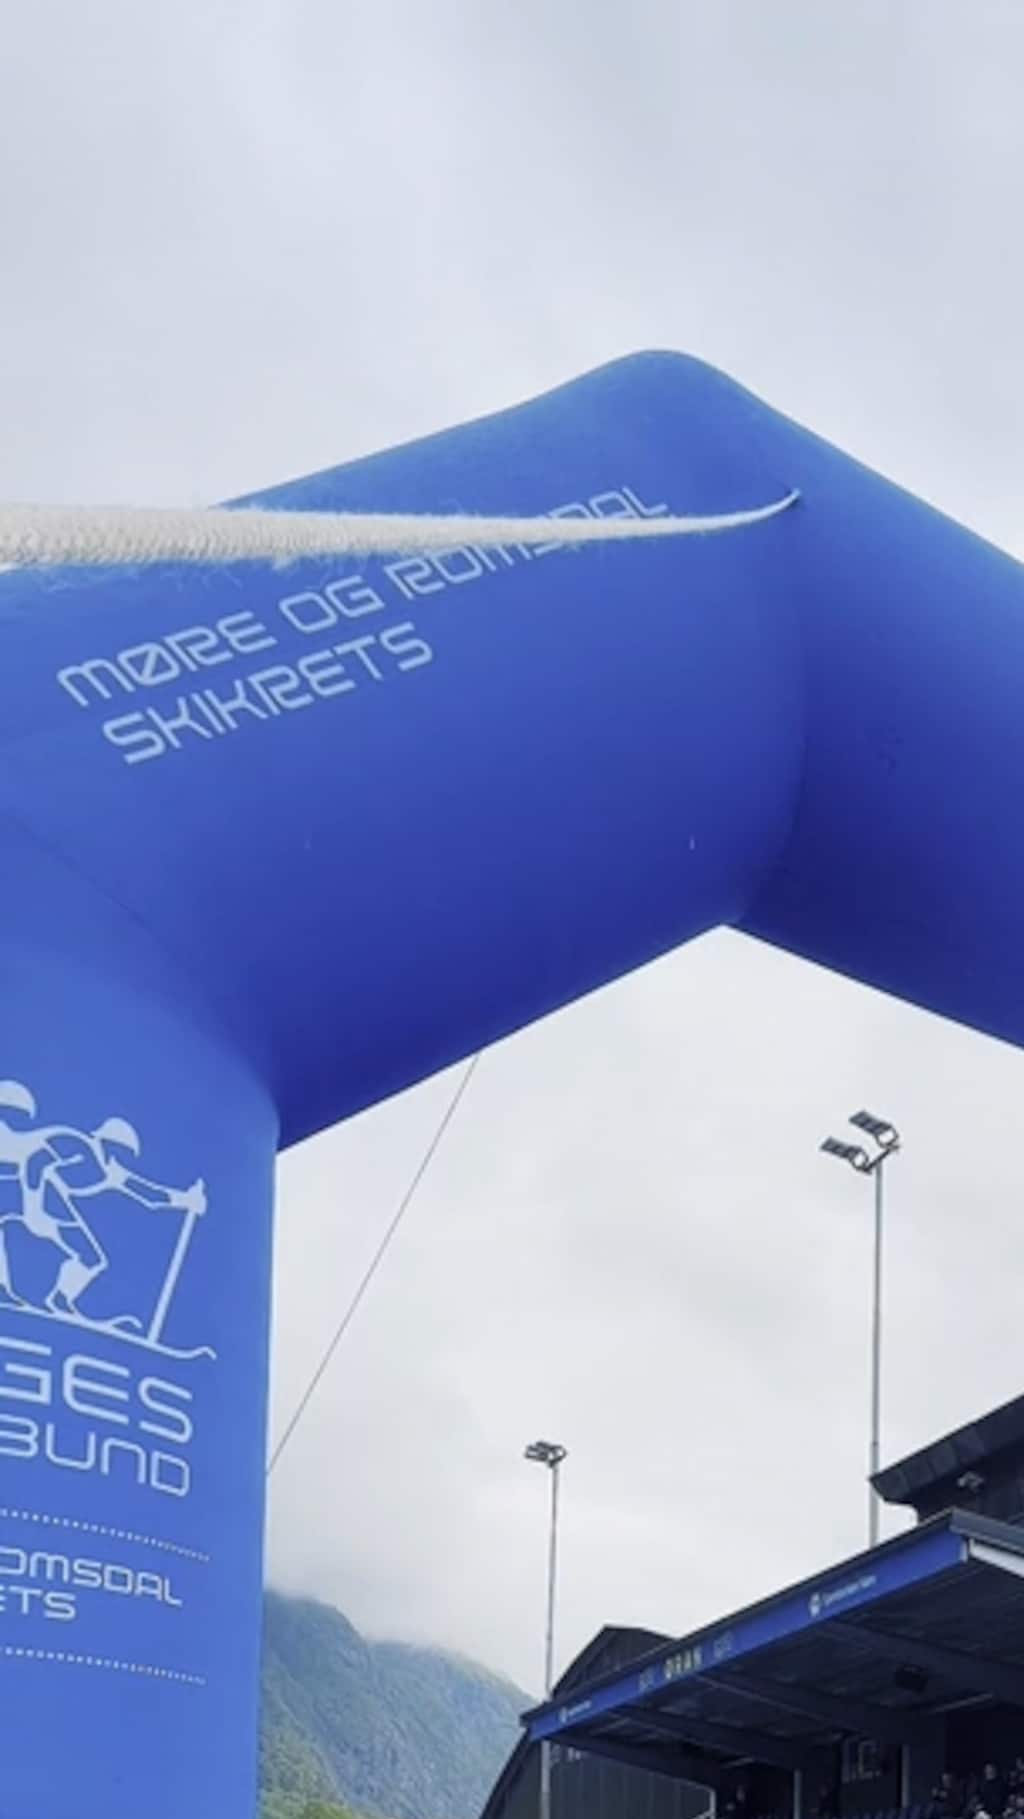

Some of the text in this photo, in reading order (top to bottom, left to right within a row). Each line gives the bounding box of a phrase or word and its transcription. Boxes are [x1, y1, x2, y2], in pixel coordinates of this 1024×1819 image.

[56, 610, 277, 707] MØRE
[278, 574, 386, 635] OG
[102, 621, 433, 765] SKIKRETS
